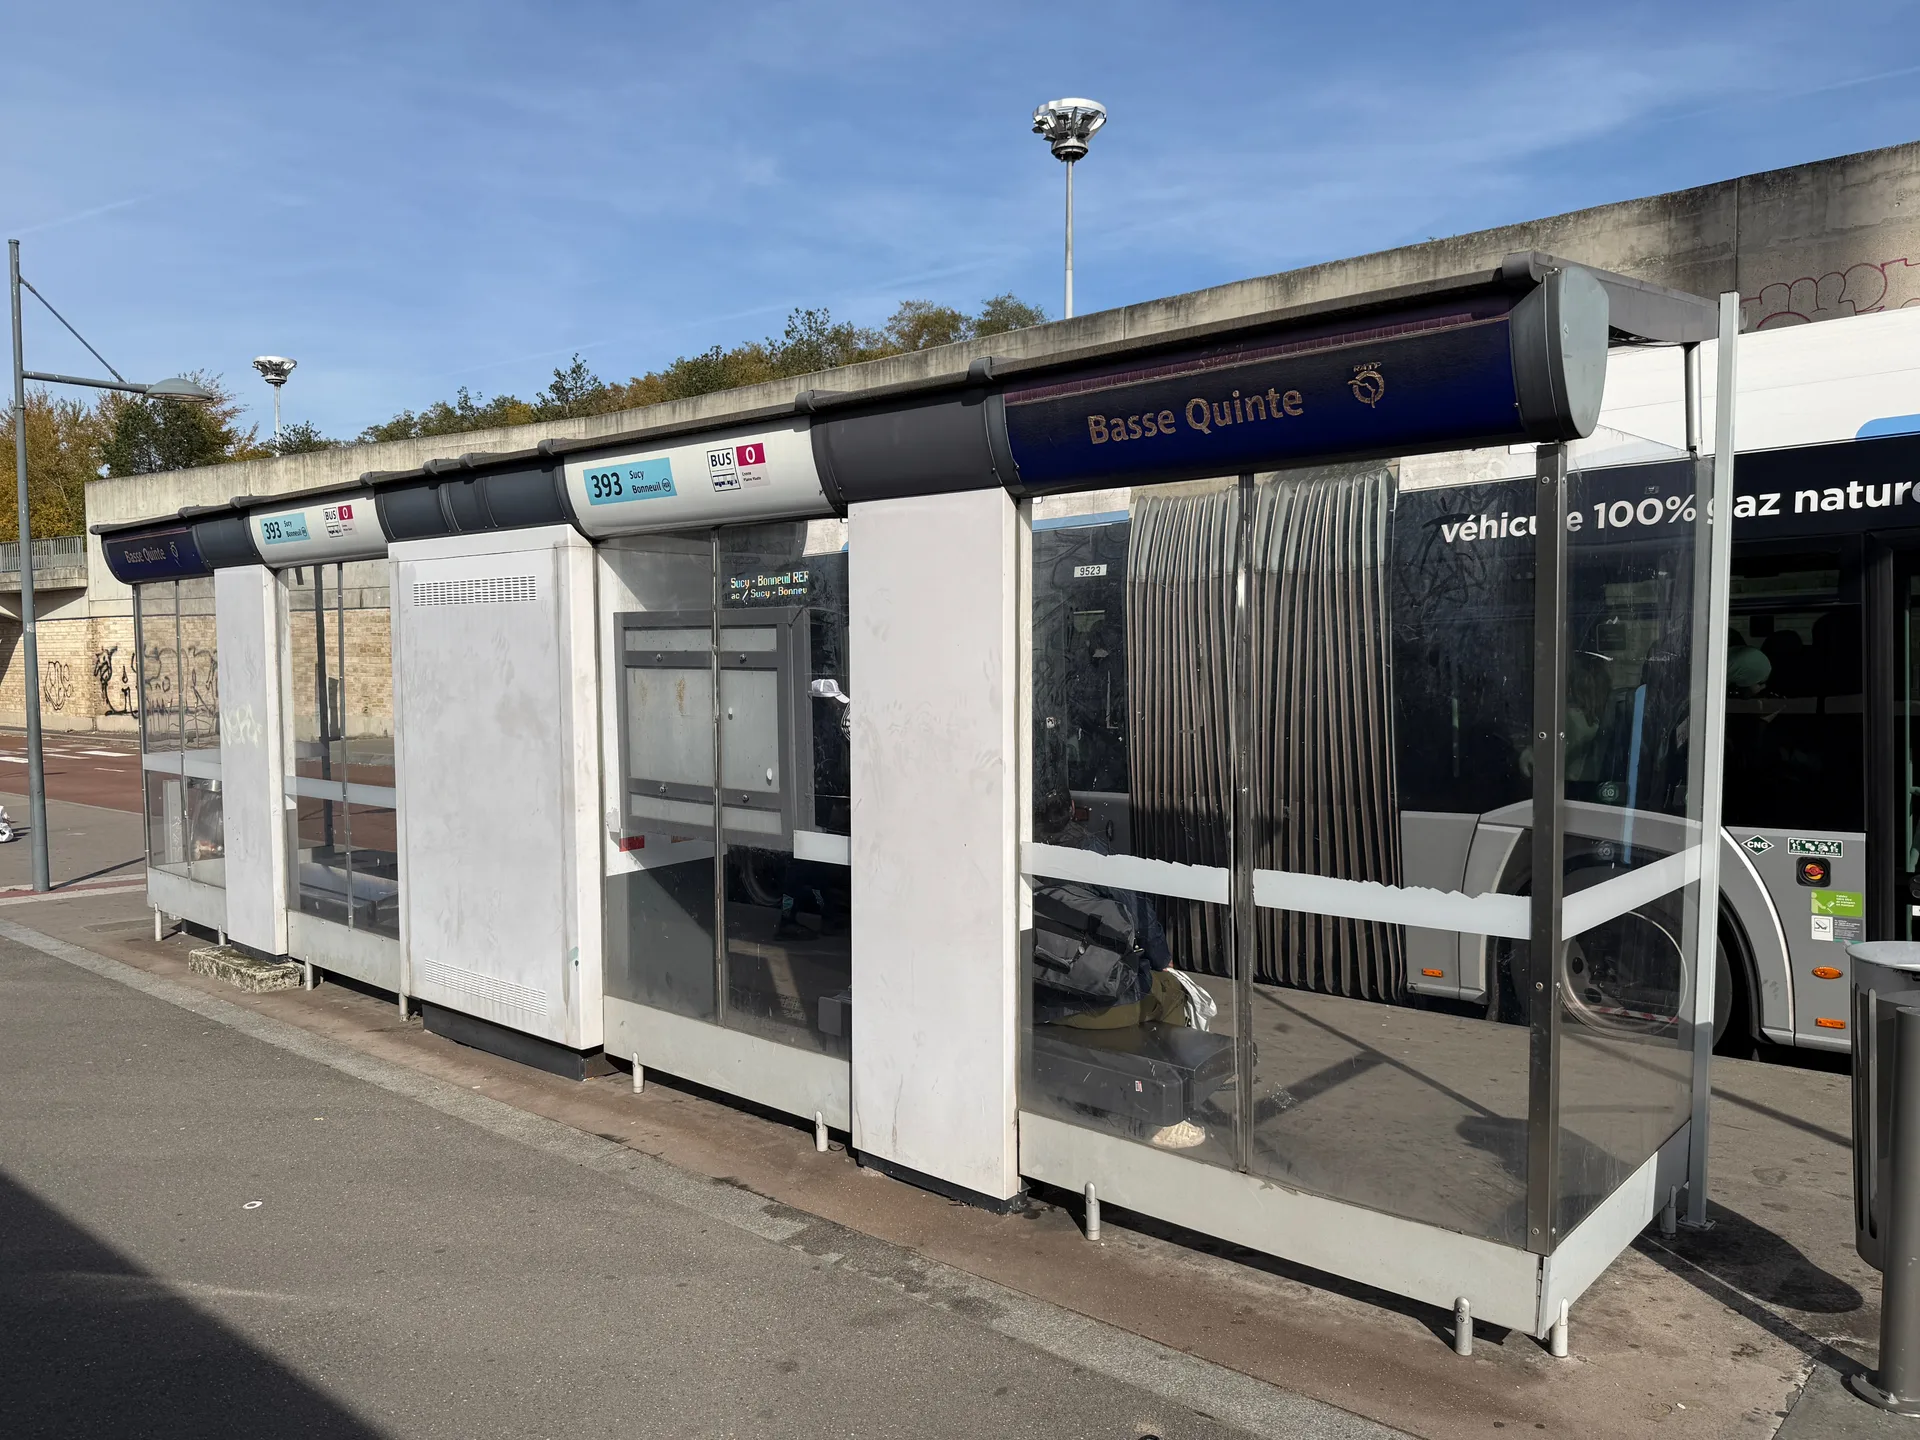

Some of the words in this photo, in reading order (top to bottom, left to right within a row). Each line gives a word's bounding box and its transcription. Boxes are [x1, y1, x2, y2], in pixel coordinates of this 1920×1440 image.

[1087, 409, 1176, 445] Basse
[1185, 387, 1304, 435] Quinte
[710, 452, 732, 467] BUS
[629, 470, 644, 480] Sucy
[590, 472, 623, 498] 393
[631, 481, 661, 494] Bonneuil
[324, 510, 337, 521] BUS
[1441, 510, 1584, 544] véhice
[1593, 493, 1697, 530] 100%
[263, 521, 282, 540] 393
[124, 550, 144, 564] Basse
[142, 547, 167, 564] Quinte
[1080, 566, 1101, 576] 9523
[730, 577, 750, 589] Sucy
[757, 572, 791, 586] Bonneuil
[750, 589, 770, 598] Sucy
[1747, 841, 1768, 849] CNG
